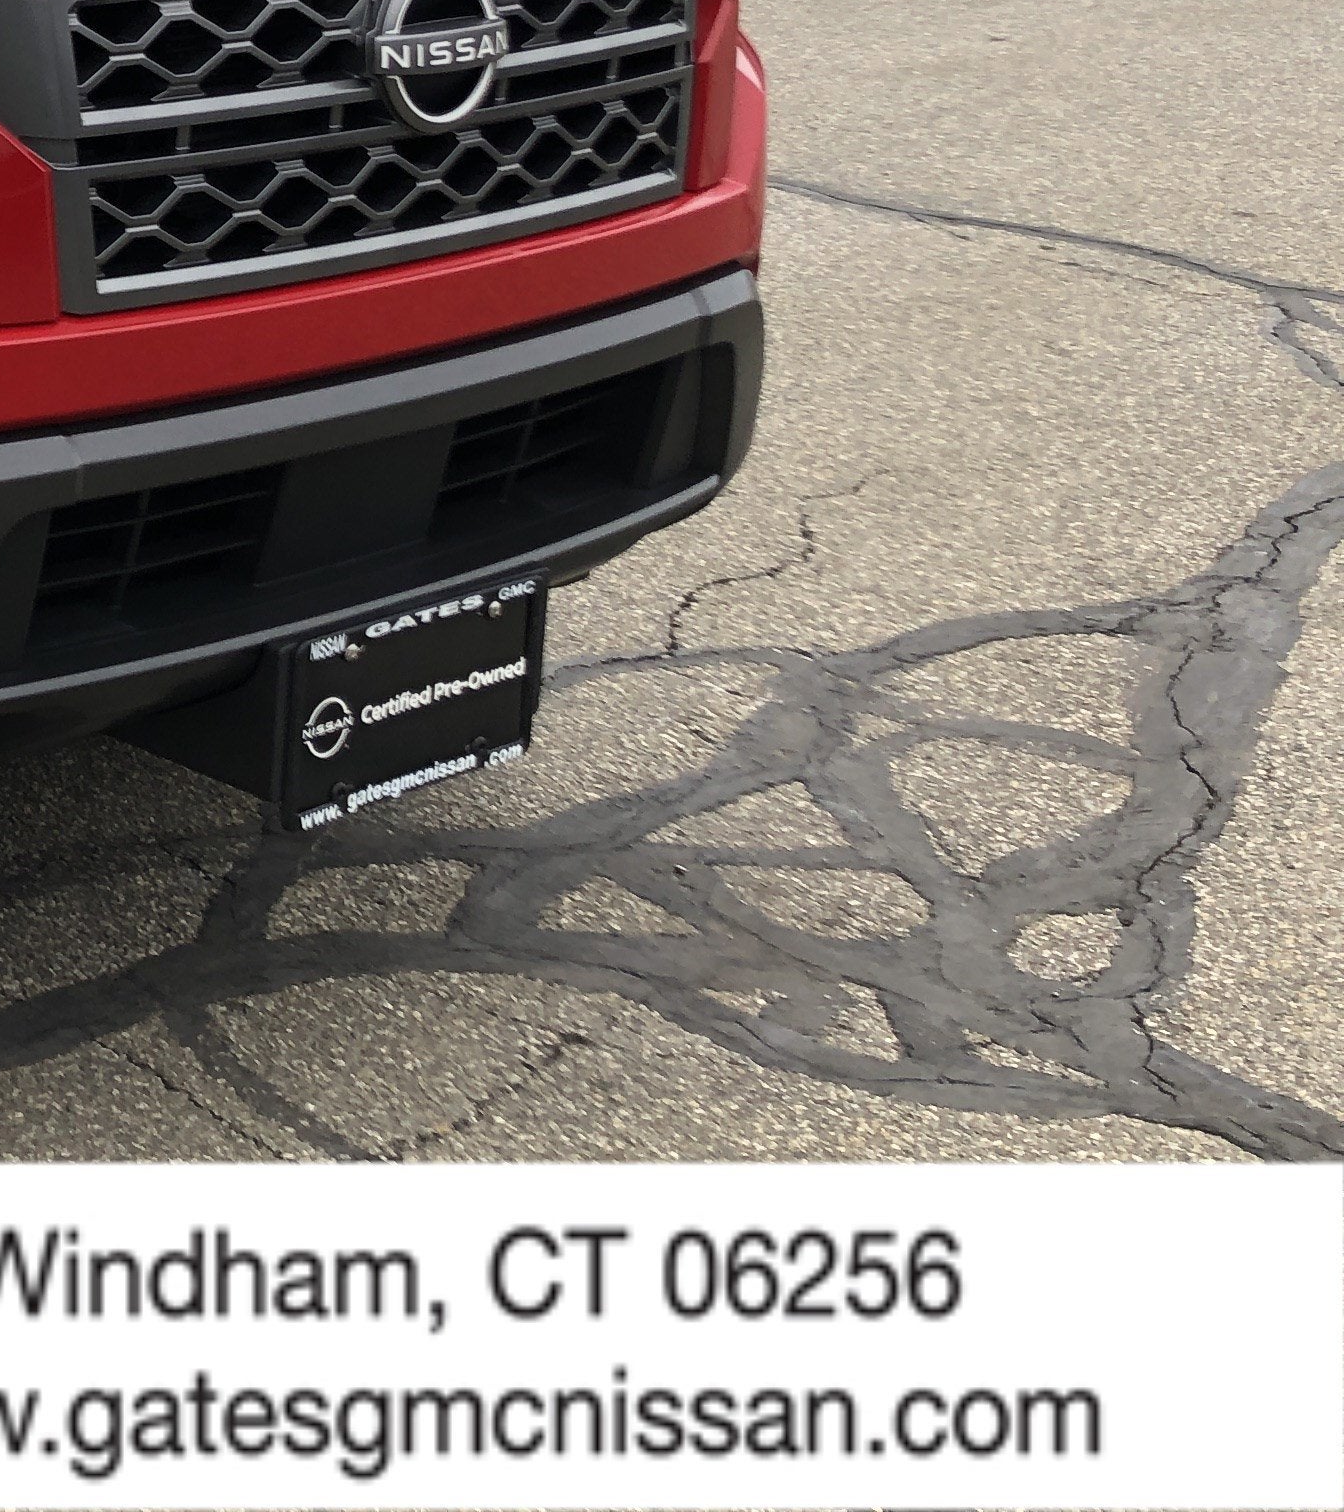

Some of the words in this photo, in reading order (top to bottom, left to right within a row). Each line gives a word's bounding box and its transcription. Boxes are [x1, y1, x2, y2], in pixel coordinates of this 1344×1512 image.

[380, 30, 510, 70] NISSAN
[309, 633, 348, 662] NISSAN
[365, 593, 485, 639] GATES
[498, 580, 537, 601] GMC
[360, 685, 433, 725] Certified
[434, 655, 527, 701] Pre-Owned
[302, 715, 355, 742] NISSAN
